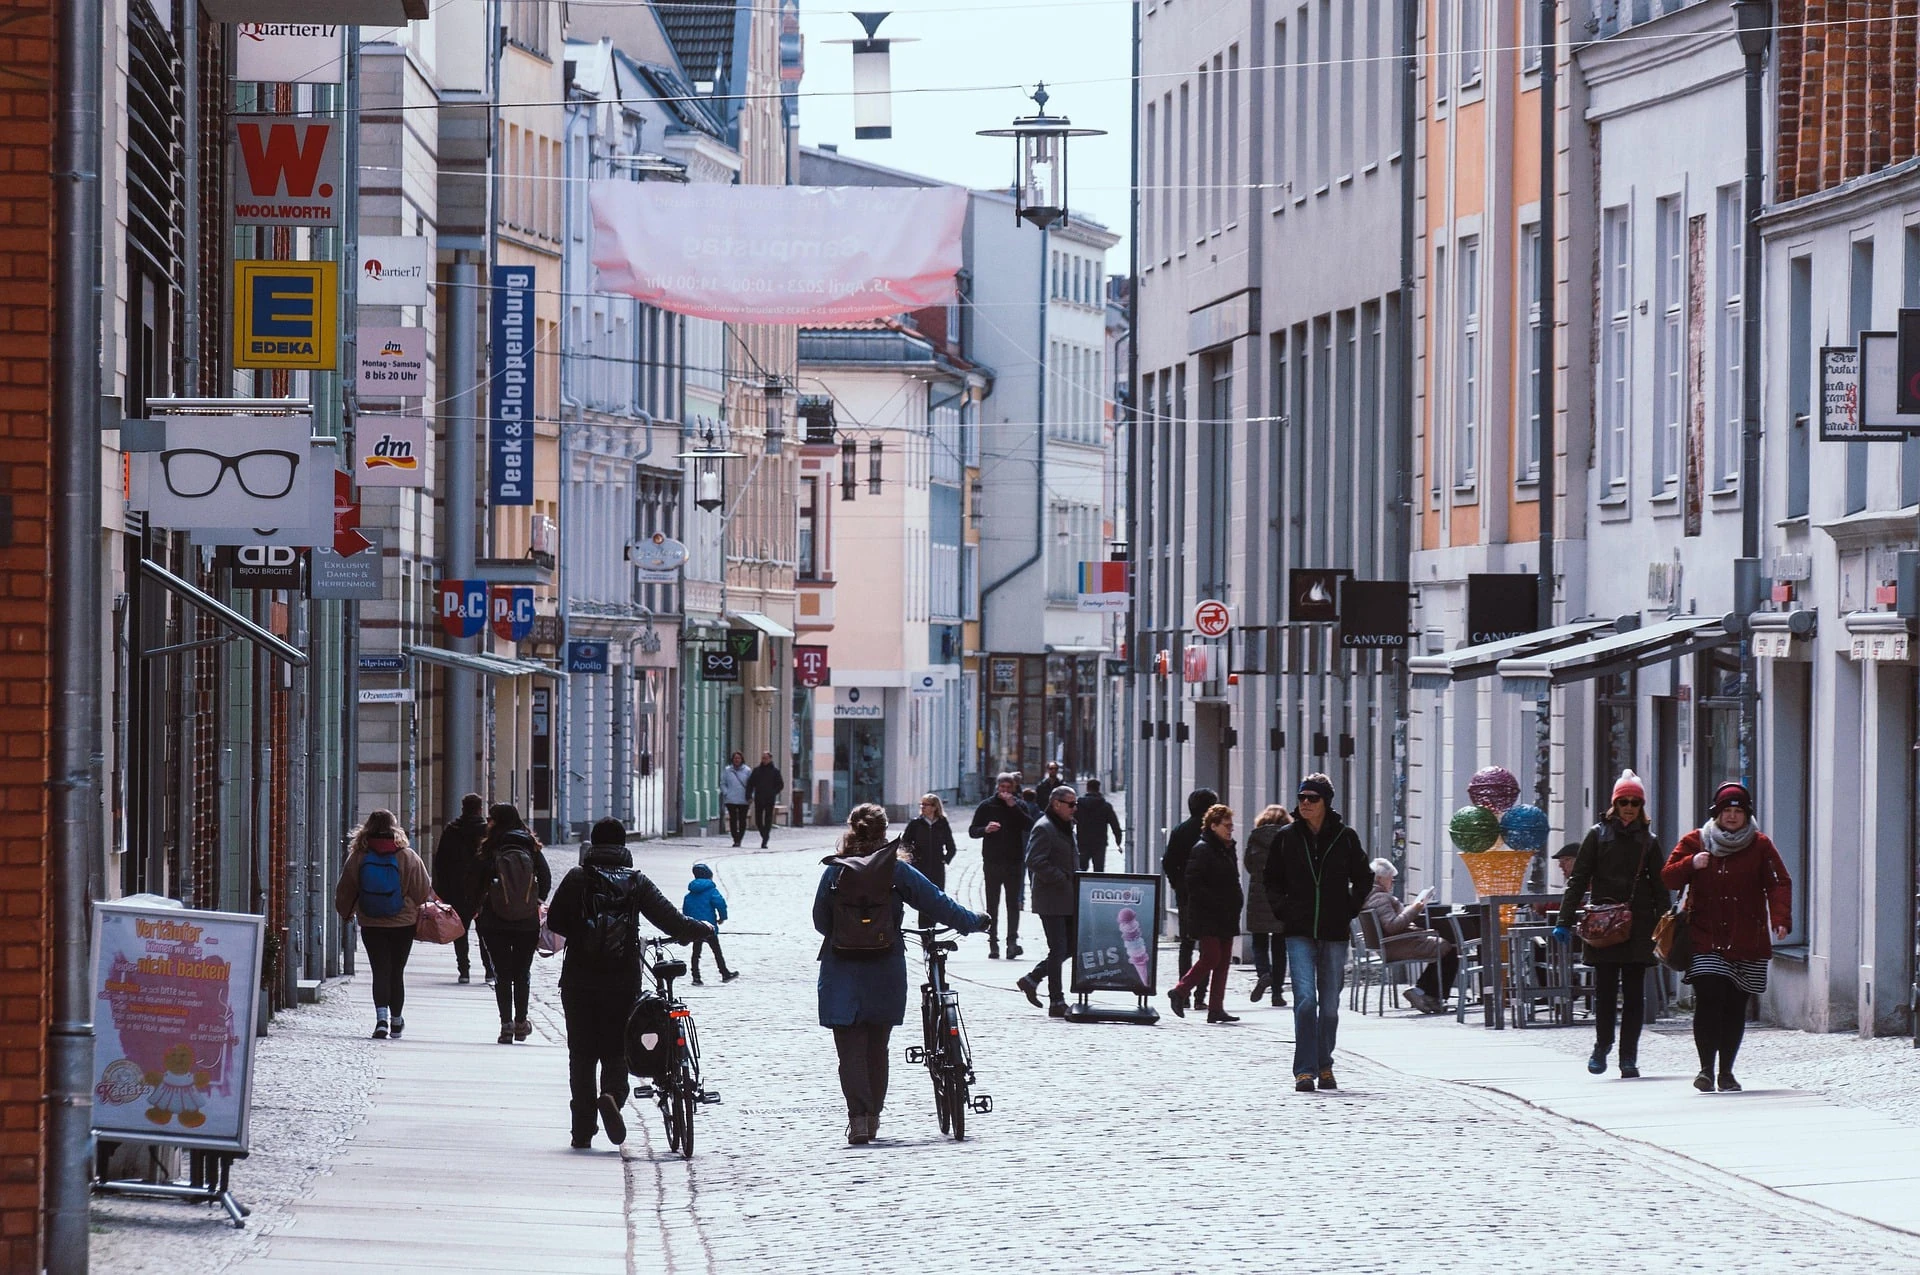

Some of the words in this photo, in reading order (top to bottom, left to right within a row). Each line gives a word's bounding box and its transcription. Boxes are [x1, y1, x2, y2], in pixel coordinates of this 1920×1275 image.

[235, 205, 331, 219] WOOLWORTH
[364, 259, 422, 281] Quartier17
[252, 341, 313, 355] EDEKA
[384, 341, 401, 351] dm
[362, 360, 387, 369] Montag
[392, 360, 421, 370] Samstag
[365, 371, 371, 380] 8
[373, 371, 386, 380] bis
[388, 371, 399, 381] 20
[401, 371, 417, 381] Uhr
[374, 435, 411, 457] dm
[239, 568, 260, 576] BIJOU
[262, 568, 293, 576] BRIGITTE
[443, 592, 483, 618] P&C
[494, 598, 530, 623] P&C
[1344, 635, 1403, 645] CANVERO
[573, 660, 602, 671] Apollo
[136, 918, 204, 943] Verkäufer
[145, 940, 173, 953] können
[174, 944, 187, 954] wir
[188, 946, 203, 957] uns
[1081, 946, 1120, 969] EIS
[138, 955, 174, 976] nicht
[177, 957, 231, 981] backen!
